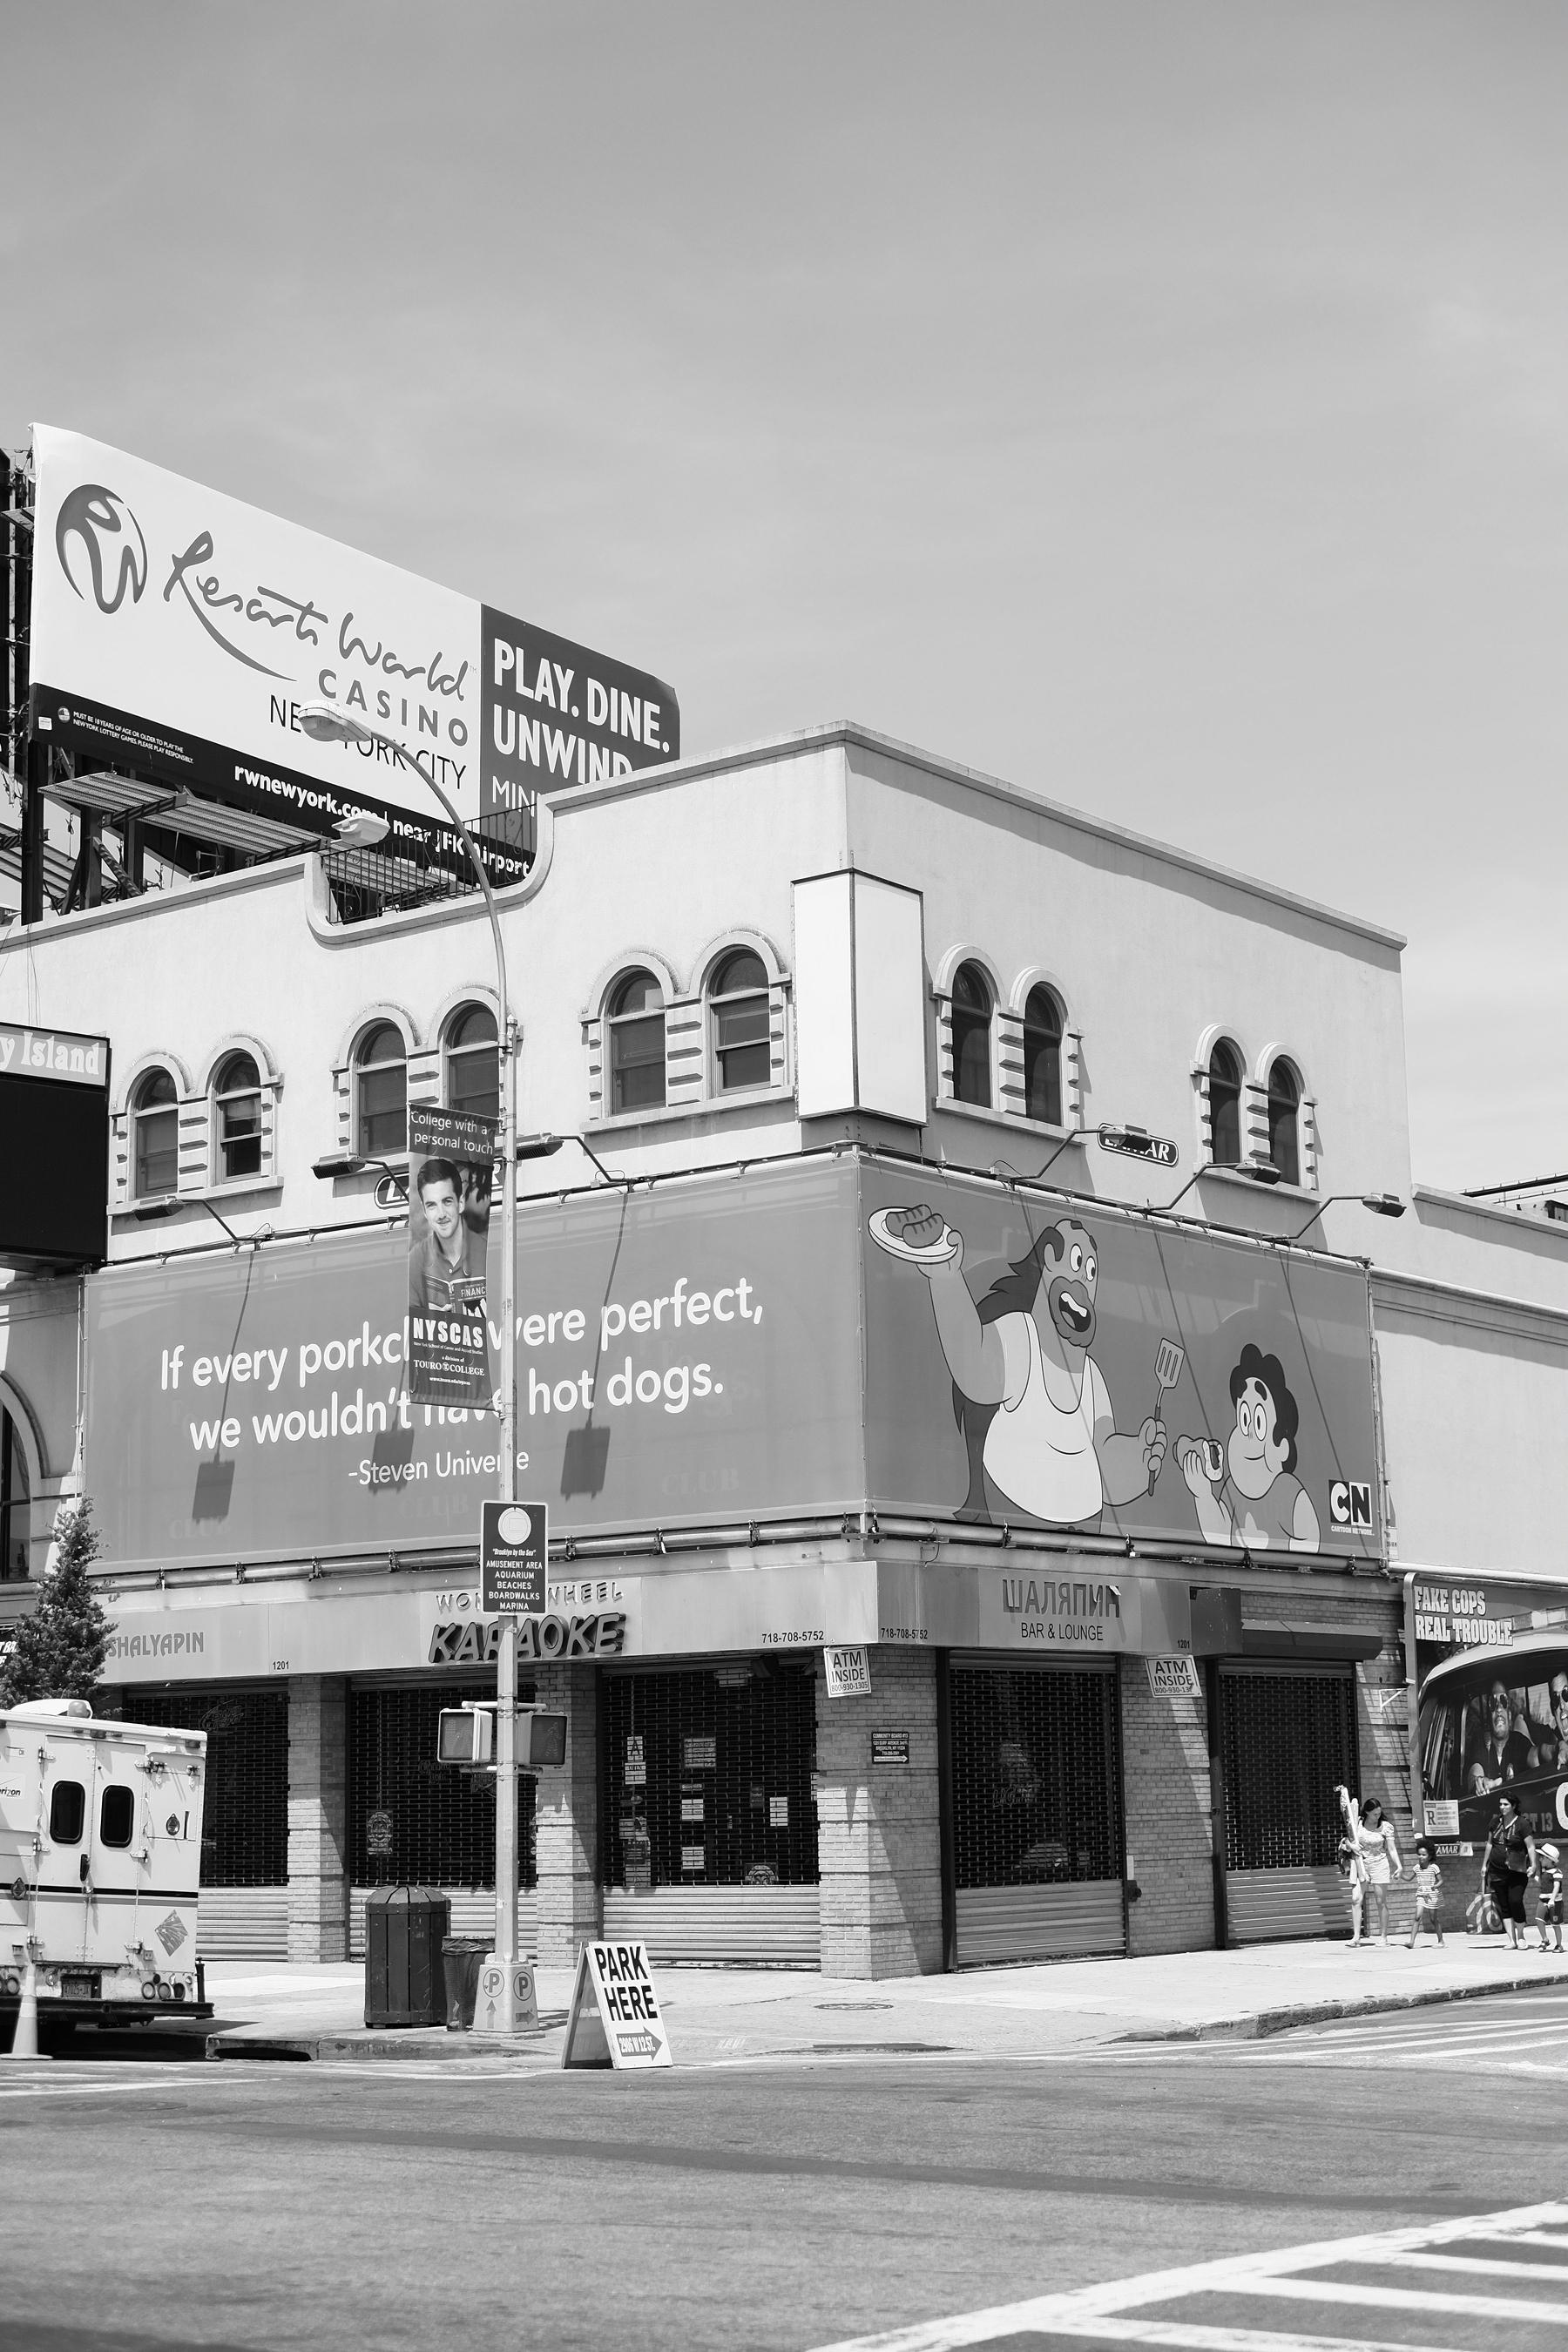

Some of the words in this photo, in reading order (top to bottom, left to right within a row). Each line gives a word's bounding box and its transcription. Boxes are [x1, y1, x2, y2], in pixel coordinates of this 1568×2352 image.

[339, 612, 468, 700] World
[318, 668, 468, 747] CASINO
[494, 638, 579, 718] PLAY.
[587, 678, 670, 753] DINE.
[270, 694, 301, 733] NE
[73, 711, 87, 720] MUST
[100, 720, 114, 730] YEARS
[122, 727, 132, 736] AGE
[140, 733, 156, 744] OLDER
[164, 740, 174, 750] PLAY
[174, 745, 184, 754] THE
[73, 719, 86, 727] NEW
[86, 722, 98, 732] YORK
[99, 727, 120, 739] LOTTERY
[138, 740, 153, 750] PLEASE
[154, 745, 165, 754] PLAY
[394, 820, 432, 844] near
[436, 828, 464, 856] JFK
[21, 1031, 99, 1075] Island
[410, 1111, 451, 1131] College
[456, 1118, 477, 1133] with
[482, 1125, 488, 1135] a
[415, 1132, 460, 1149] personal
[464, 1139, 493, 1155] touch
[161, 1345, 184, 1390] If
[193, 1348, 288, 1391] every
[601, 1277, 763, 1351] perfect,
[413, 1317, 483, 1348] NYSCAS
[413, 1359, 442, 1370] TOURO
[449, 1364, 485, 1375] COLLEGE
[190, 1416, 240, 1450] we
[252, 1387, 412, 1444] wouldn't
[529, 1368, 594, 1415] hot
[606, 1356, 724, 1413] dogs.
[436, 1450, 530, 1477] Univere
[1328, 1479, 1373, 1527] CN
[489, 1592, 540, 1600] BOARDWALKS
[1414, 1585, 1449, 1613] FAKE
[1451, 1589, 1486, 1616] COPS
[428, 1612, 626, 1663] KARAOKE
[761, 1630, 824, 1643] 718-708-5752
[881, 1627, 928, 1639] 718-708-5752
[1021, 1622, 1044, 1639] BAR
[1047, 1624, 1055, 1639] &
[1058, 1624, 1103, 1640] LOUNGE
[1415, 1614, 1450, 1642] REAL
[1452, 1618, 1513, 1646] TROUBLE
[108, 1632, 204, 1659] SHALYAPIN
[1177, 1639, 1190, 1649] 1201
[273, 1660, 289, 1670] 1201
[834, 1651, 862, 1668] ATM
[1155, 1661, 1188, 1673] ATM
[831, 1681, 868, 1692] 800-930-1305
[832, 1668, 865, 1683] INSIDE
[1154, 1675, 1193, 1686] INSIDE
[1426, 1810, 1436, 1826] R
[1540, 1812, 1553, 1832] 13
[1436, 1845, 1458, 1855] AMAR
[594, 1945, 648, 1982] PARK
[489, 1972, 500, 1993] P
[519, 1976, 529, 1997] P
[604, 1984, 659, 2021] HERE
[632, 2037, 640, 2052] W
